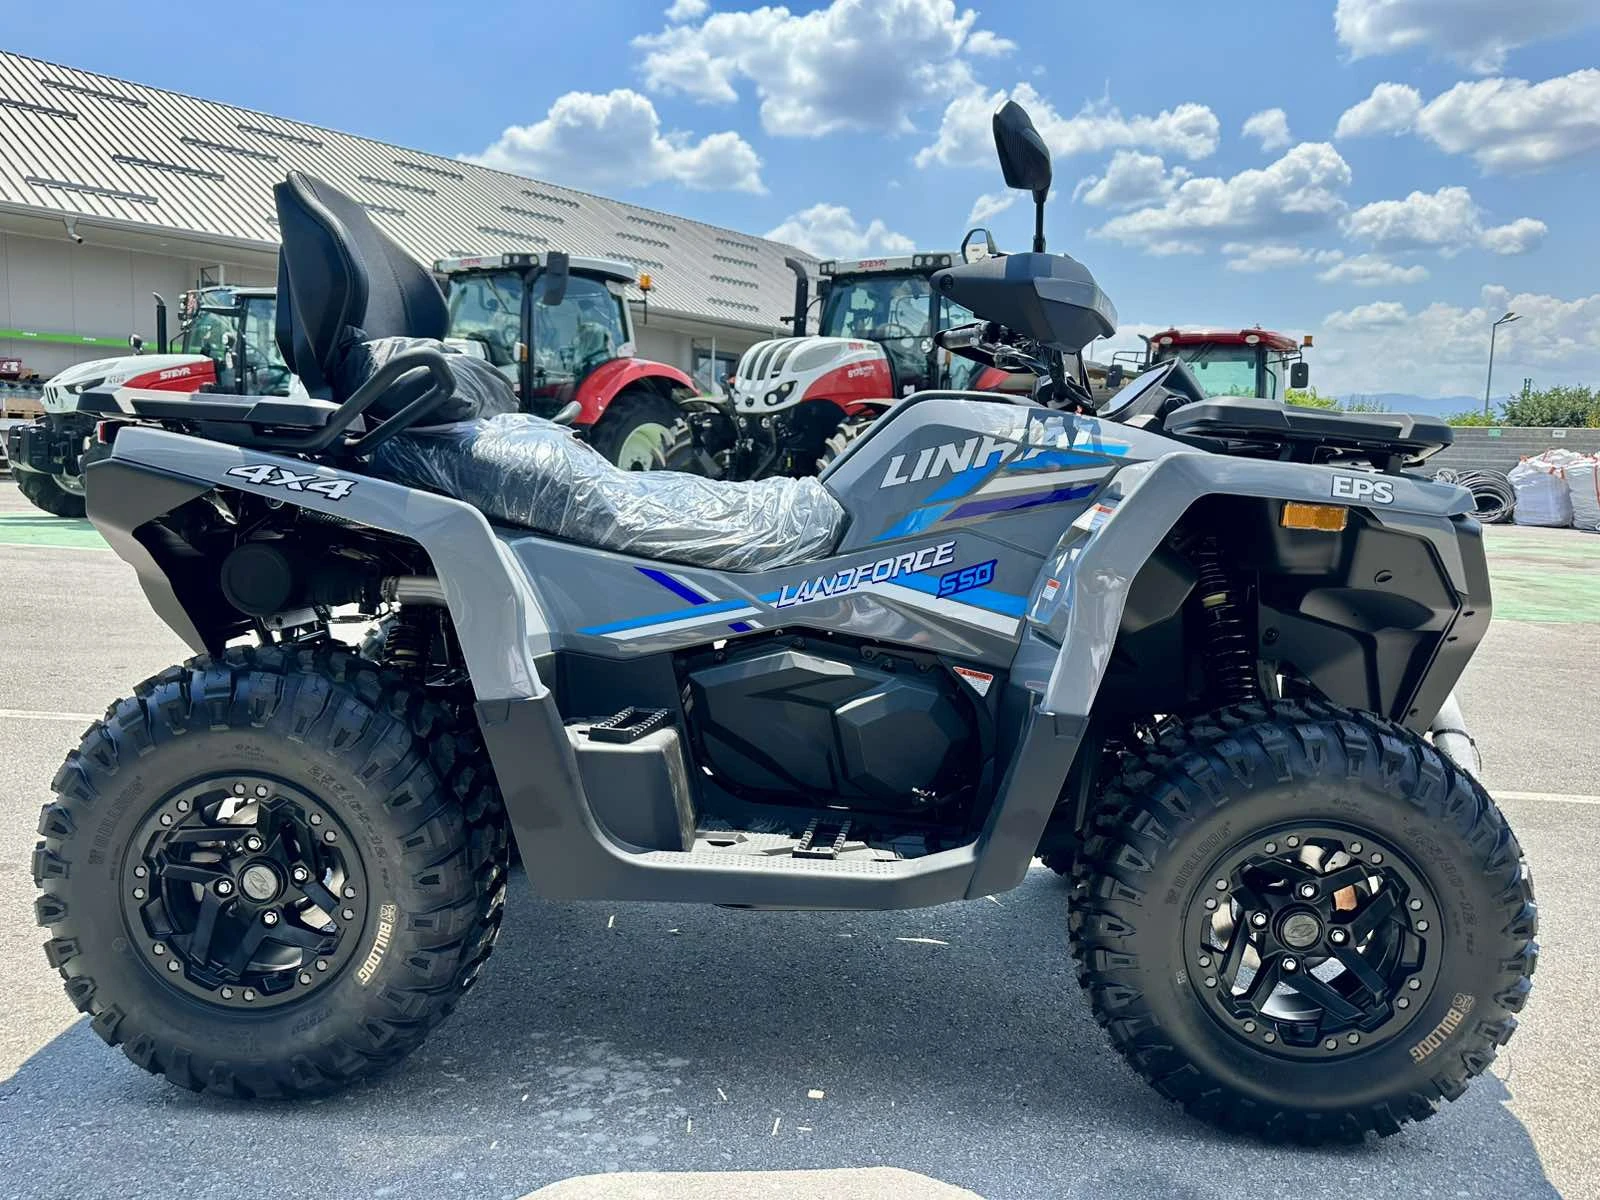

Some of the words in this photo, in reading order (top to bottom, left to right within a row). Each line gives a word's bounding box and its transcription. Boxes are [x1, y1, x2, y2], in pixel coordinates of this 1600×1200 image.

[160, 367, 191, 381] STEYR
[1331, 475, 1394, 504] EPS
[776, 541, 956, 608] LANDFORCE
[358, 921, 393, 985] BULLDOG
[1408, 1007, 1464, 1064] BULLDOG
